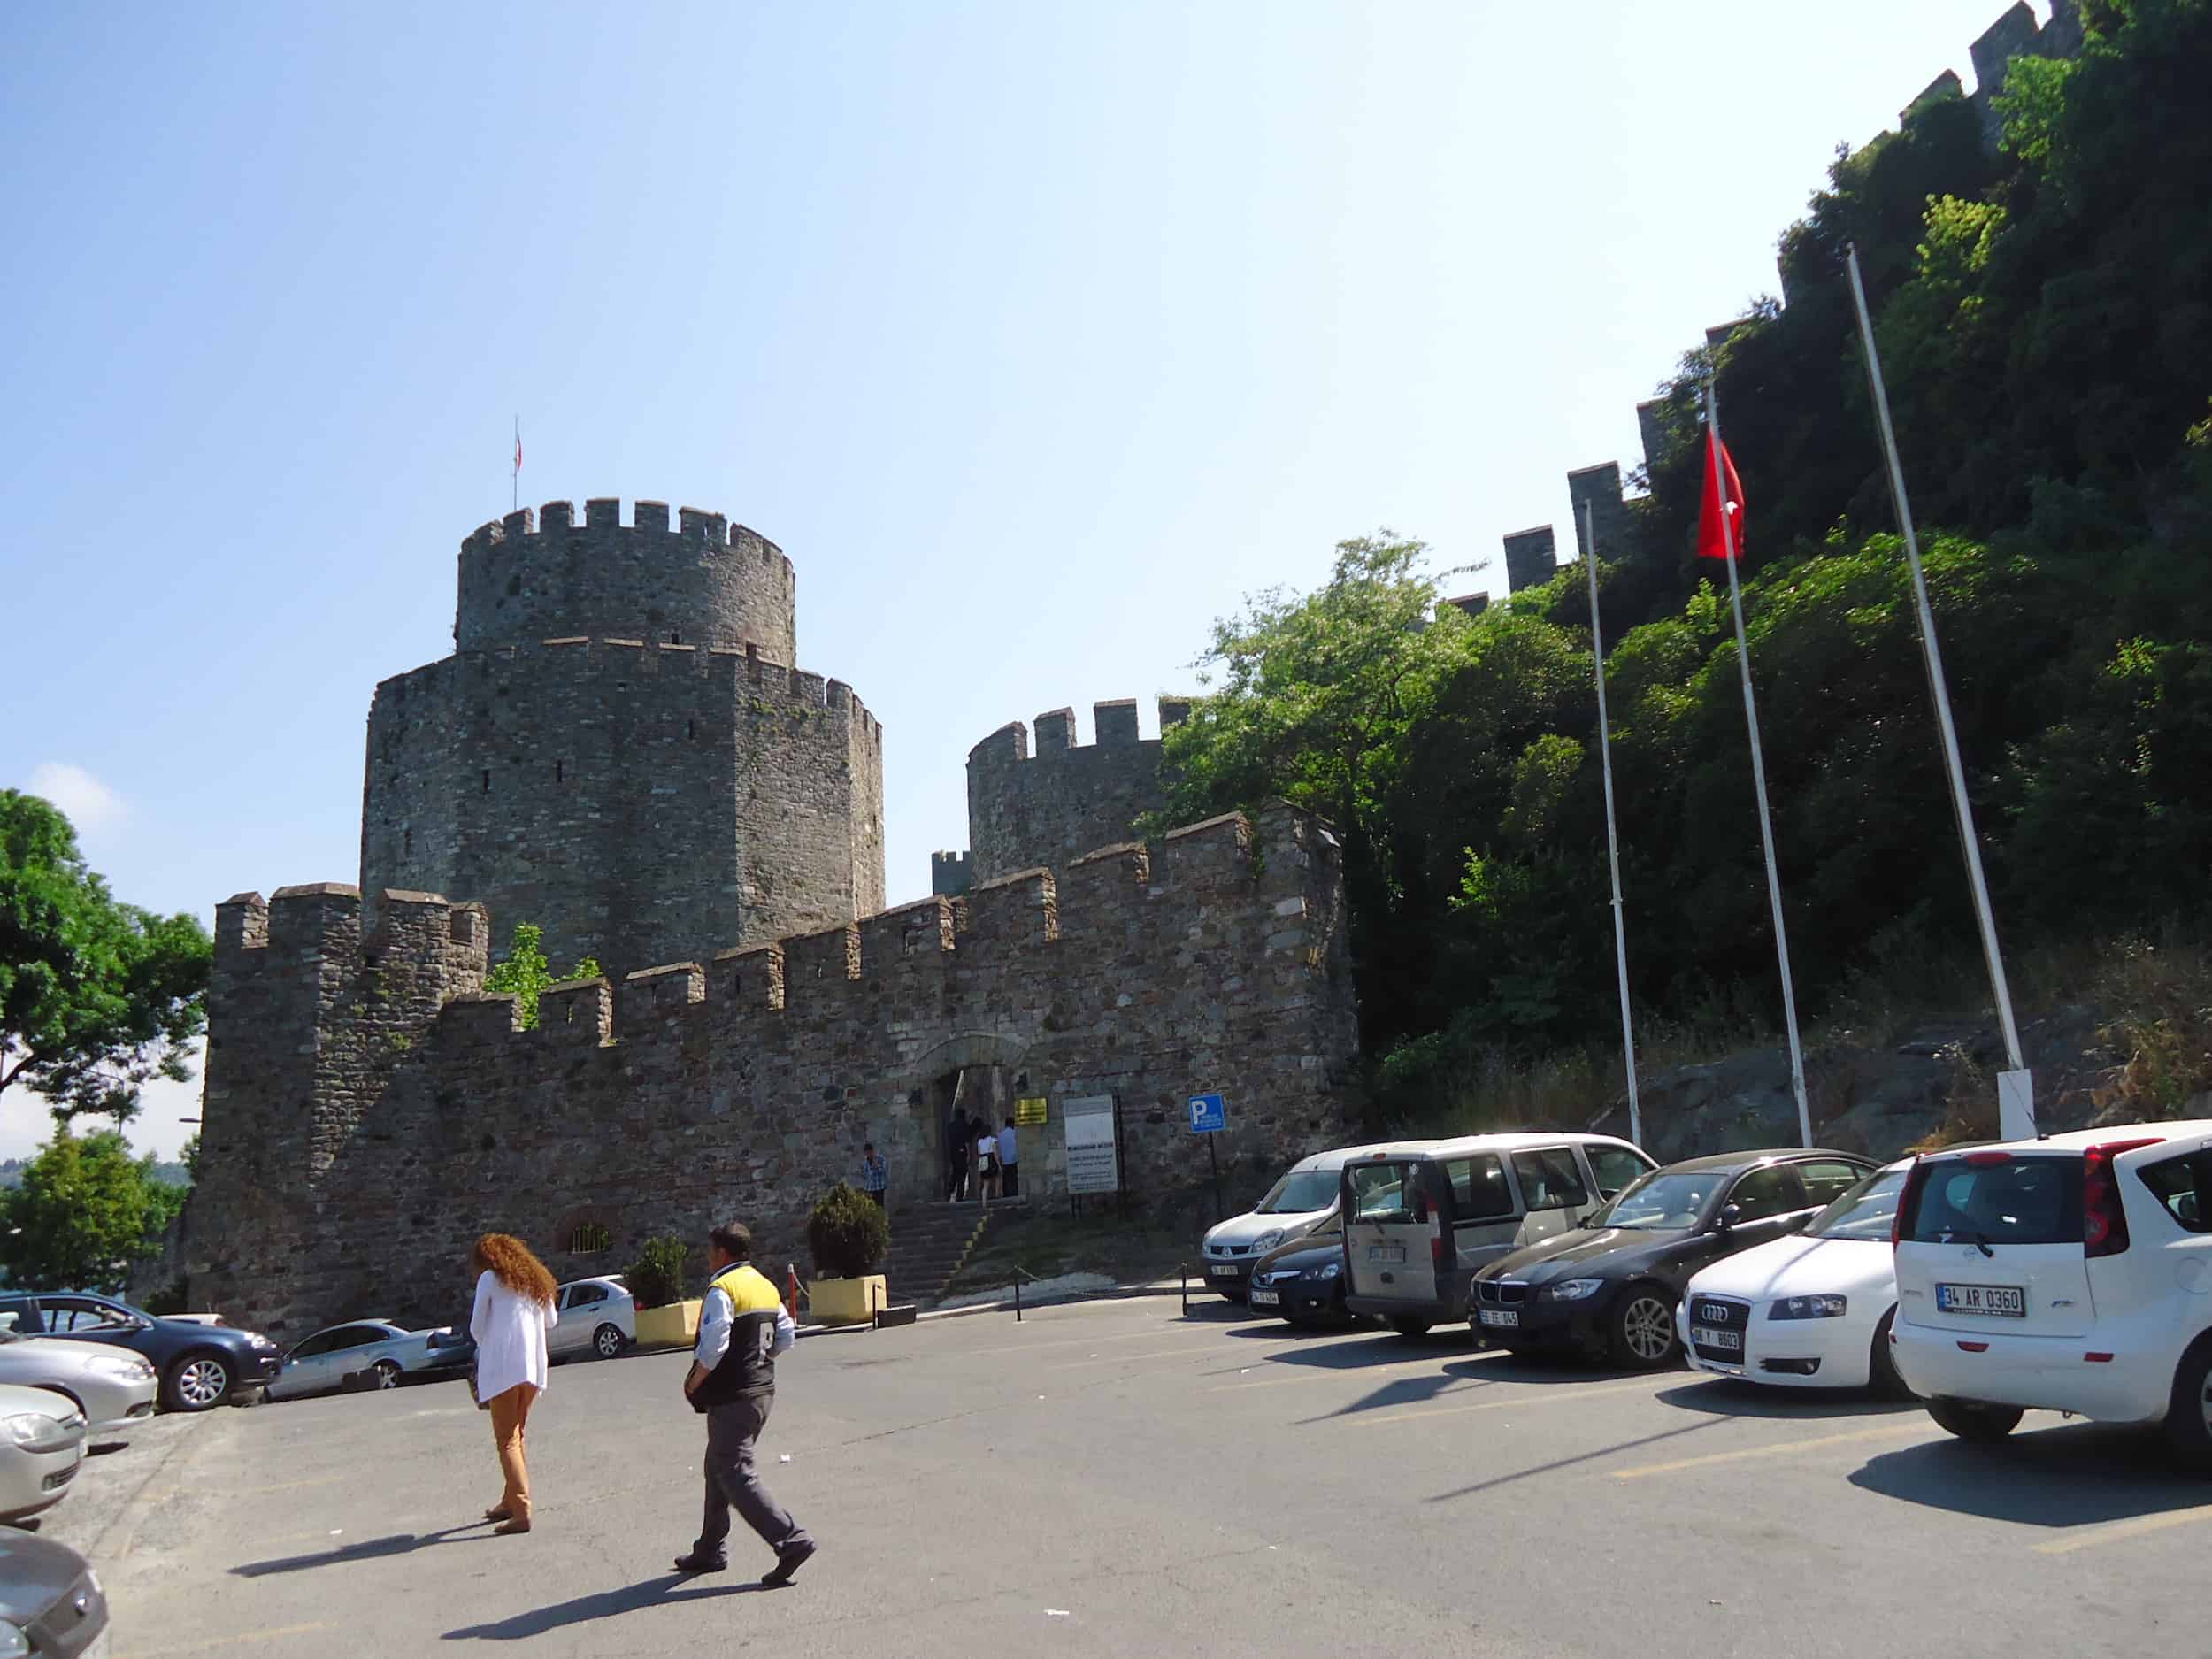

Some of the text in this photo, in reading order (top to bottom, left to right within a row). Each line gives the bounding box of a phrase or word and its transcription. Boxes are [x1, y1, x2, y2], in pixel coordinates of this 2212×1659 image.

[1192, 1100, 1207, 1125] P
[1944, 1287, 2019, 1309] 34 AR 0360
[757, 1322, 775, 1365] P
